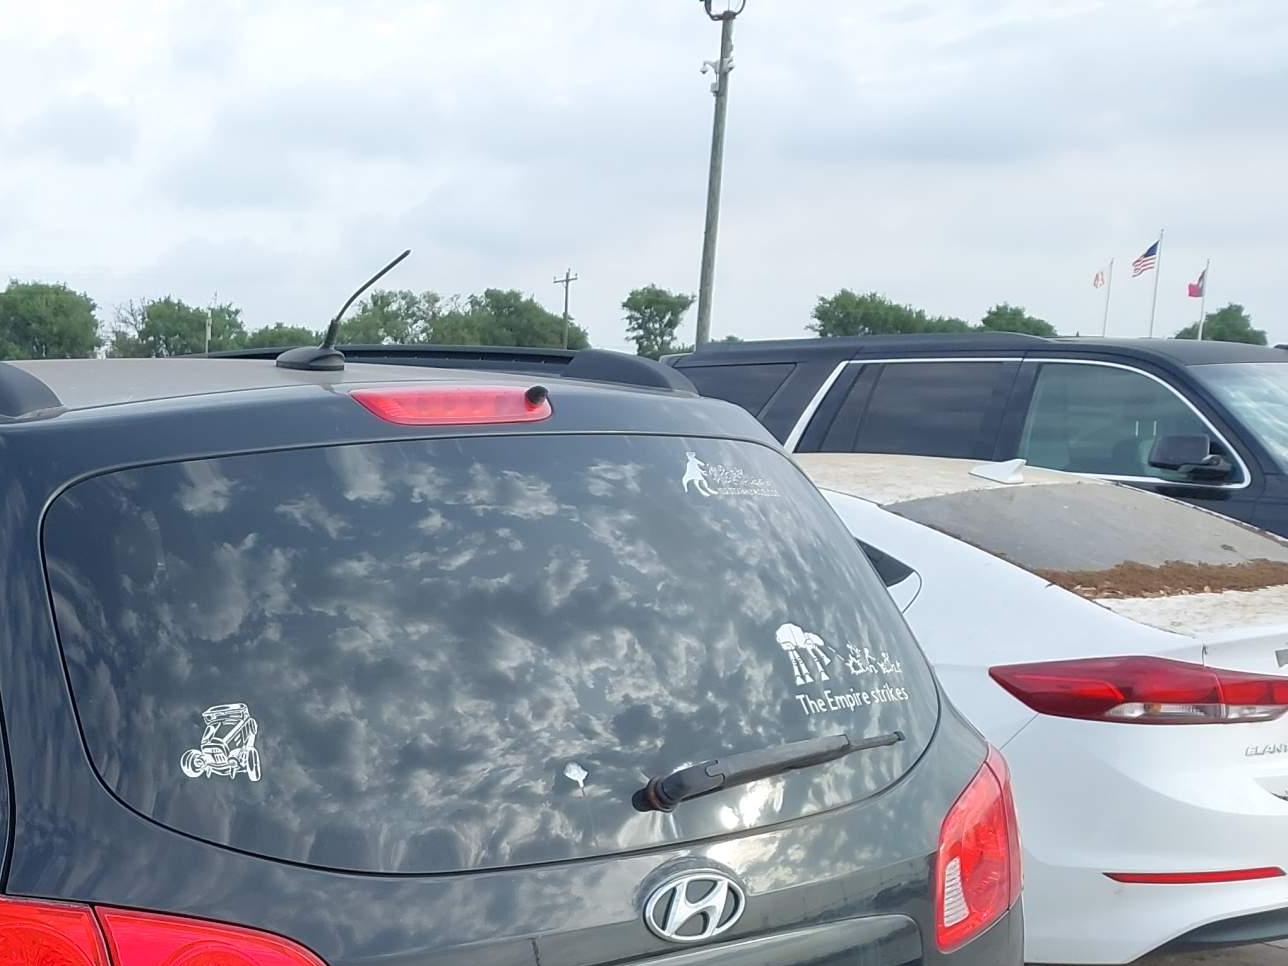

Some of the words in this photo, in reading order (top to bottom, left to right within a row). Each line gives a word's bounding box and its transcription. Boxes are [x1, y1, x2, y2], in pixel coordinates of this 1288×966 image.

[795, 694, 827, 715] The
[824, 688, 871, 711] Empire
[872, 683, 909, 704] strikes
